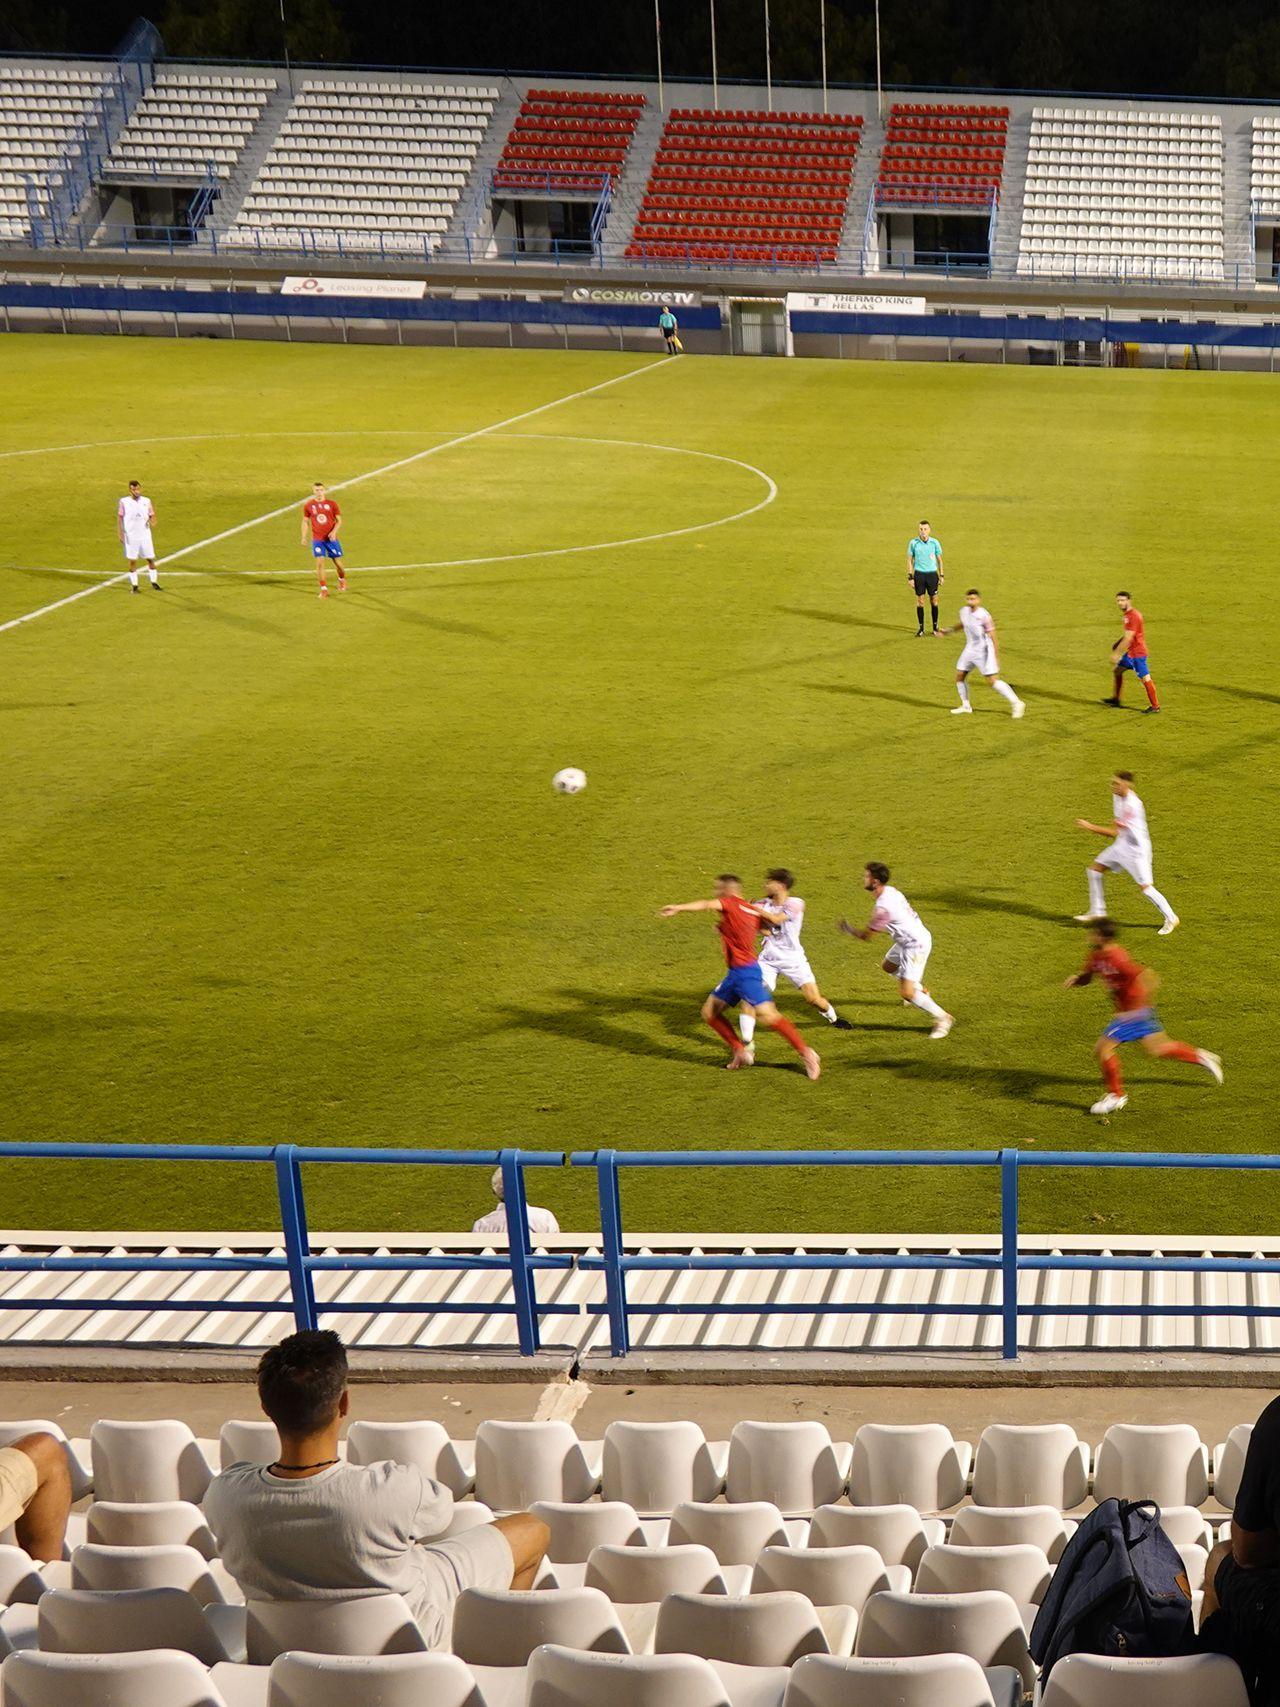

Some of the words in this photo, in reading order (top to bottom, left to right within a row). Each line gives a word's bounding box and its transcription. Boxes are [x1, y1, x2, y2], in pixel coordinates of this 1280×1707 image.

[591, 290, 672, 302] COSMOTE
[674, 292, 694, 304] TV
[834, 295, 883, 303] THERMO
[885, 297, 913, 305] KING
